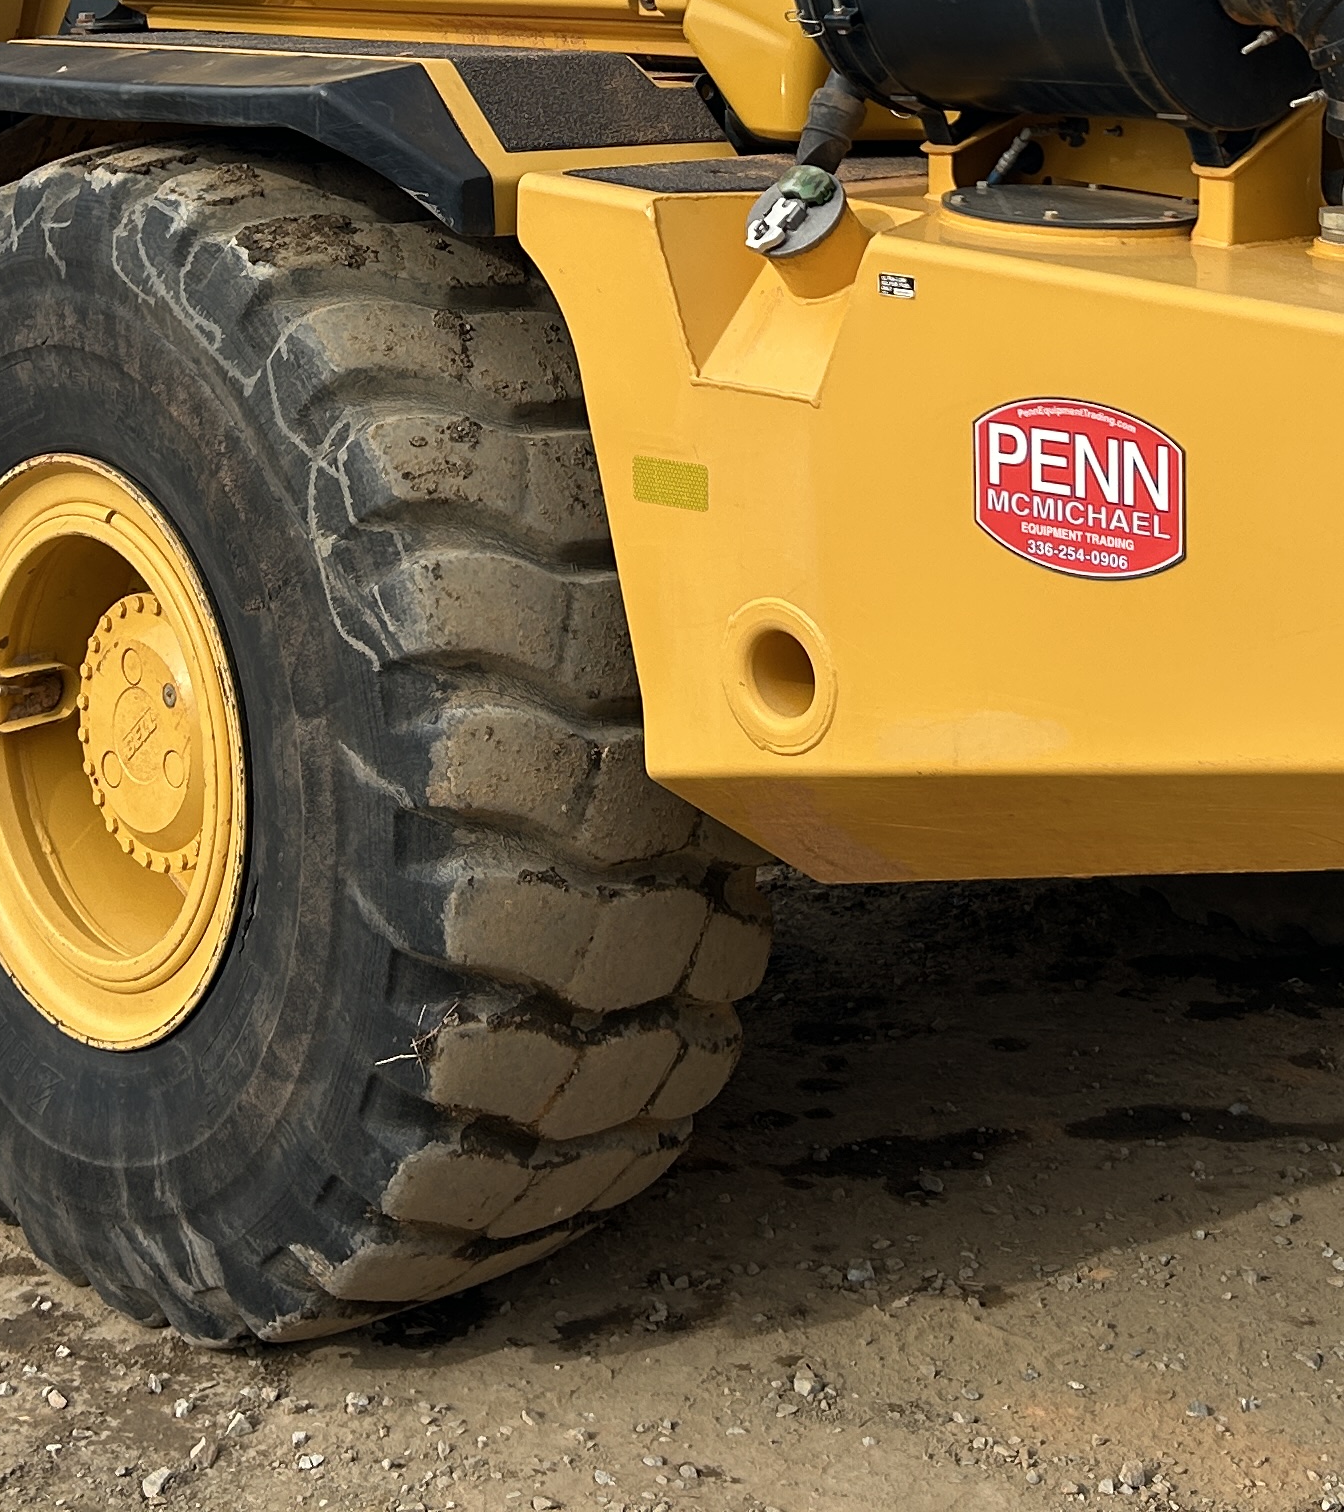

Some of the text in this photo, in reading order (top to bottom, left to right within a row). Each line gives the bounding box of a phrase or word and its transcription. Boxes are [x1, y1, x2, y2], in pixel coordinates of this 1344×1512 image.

[987, 420, 1170, 512] PENN
[986, 488, 1171, 540] MCMICHAEL
[1020, 521, 1135, 551] EQUIPMENT TRADING
[1027, 539, 1128, 570] 336-254-0906
